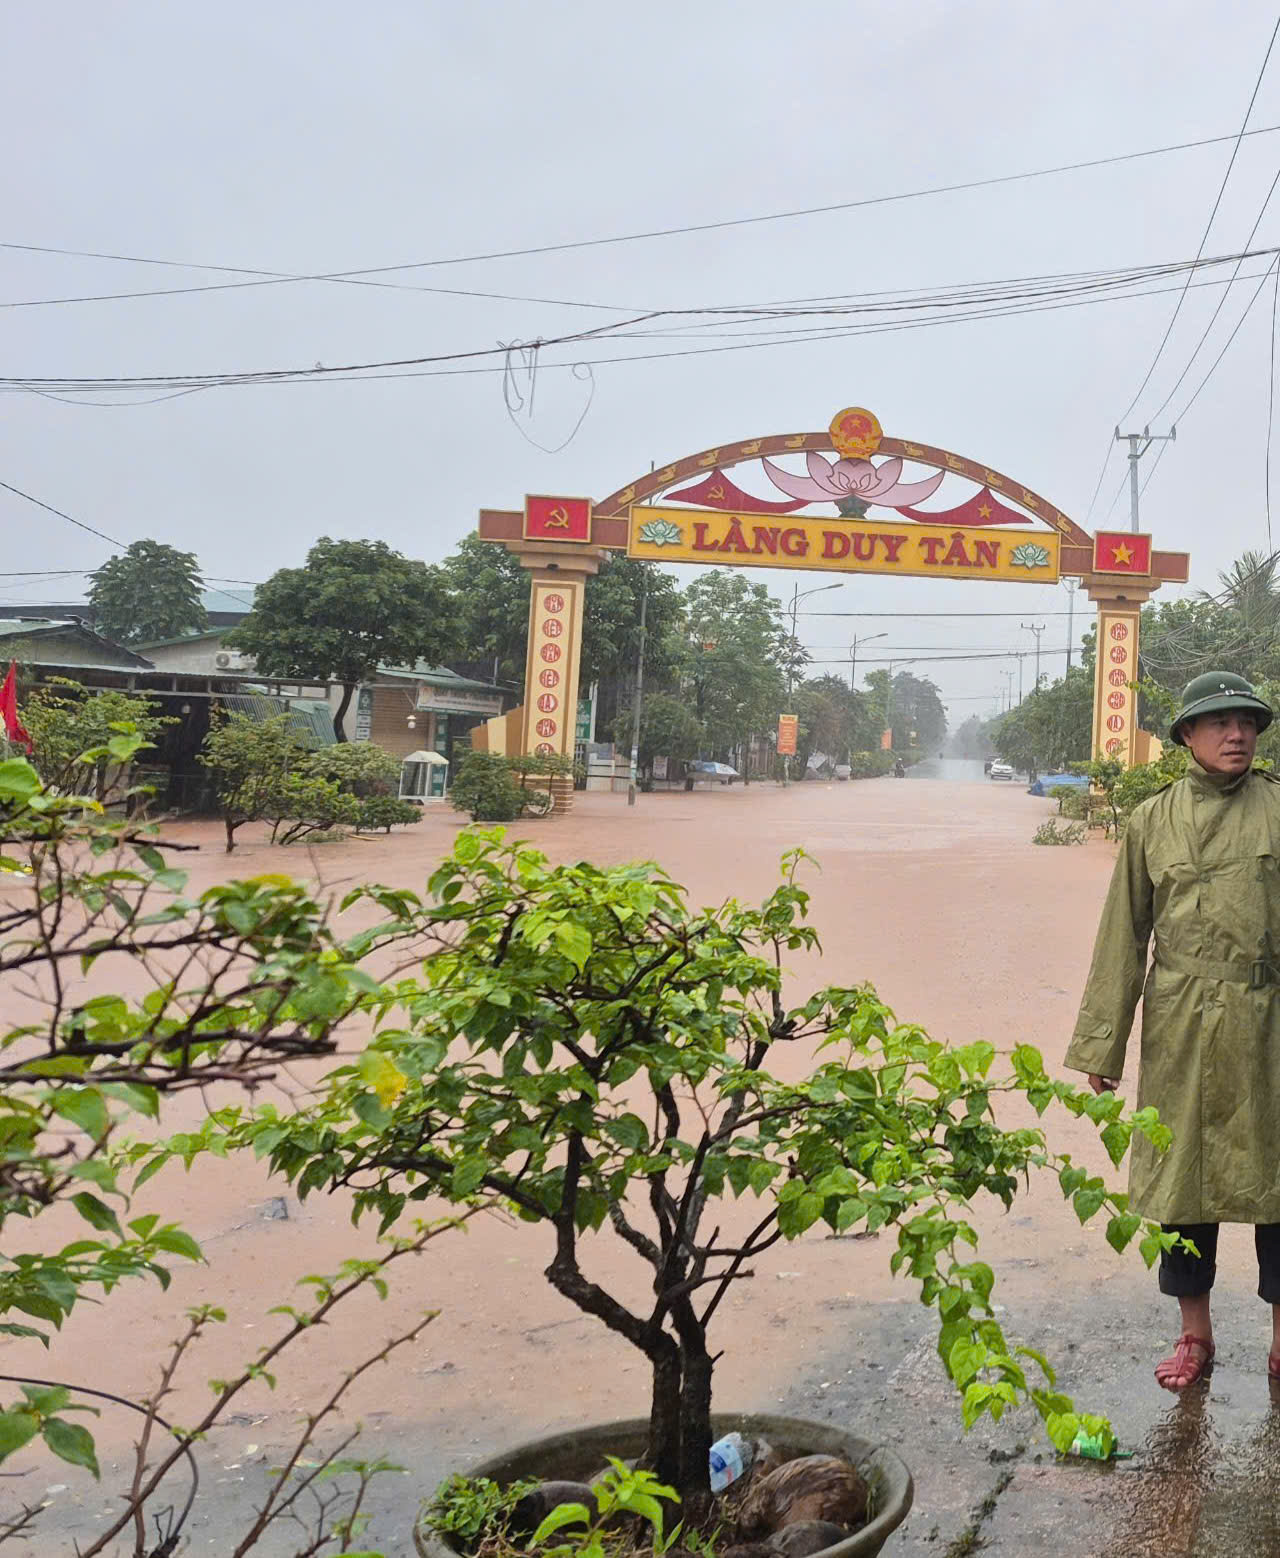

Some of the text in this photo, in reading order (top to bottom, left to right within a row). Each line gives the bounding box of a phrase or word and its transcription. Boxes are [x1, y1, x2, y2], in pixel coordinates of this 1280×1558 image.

[691, 516, 1001, 568] LÀNG DUY TÂN
